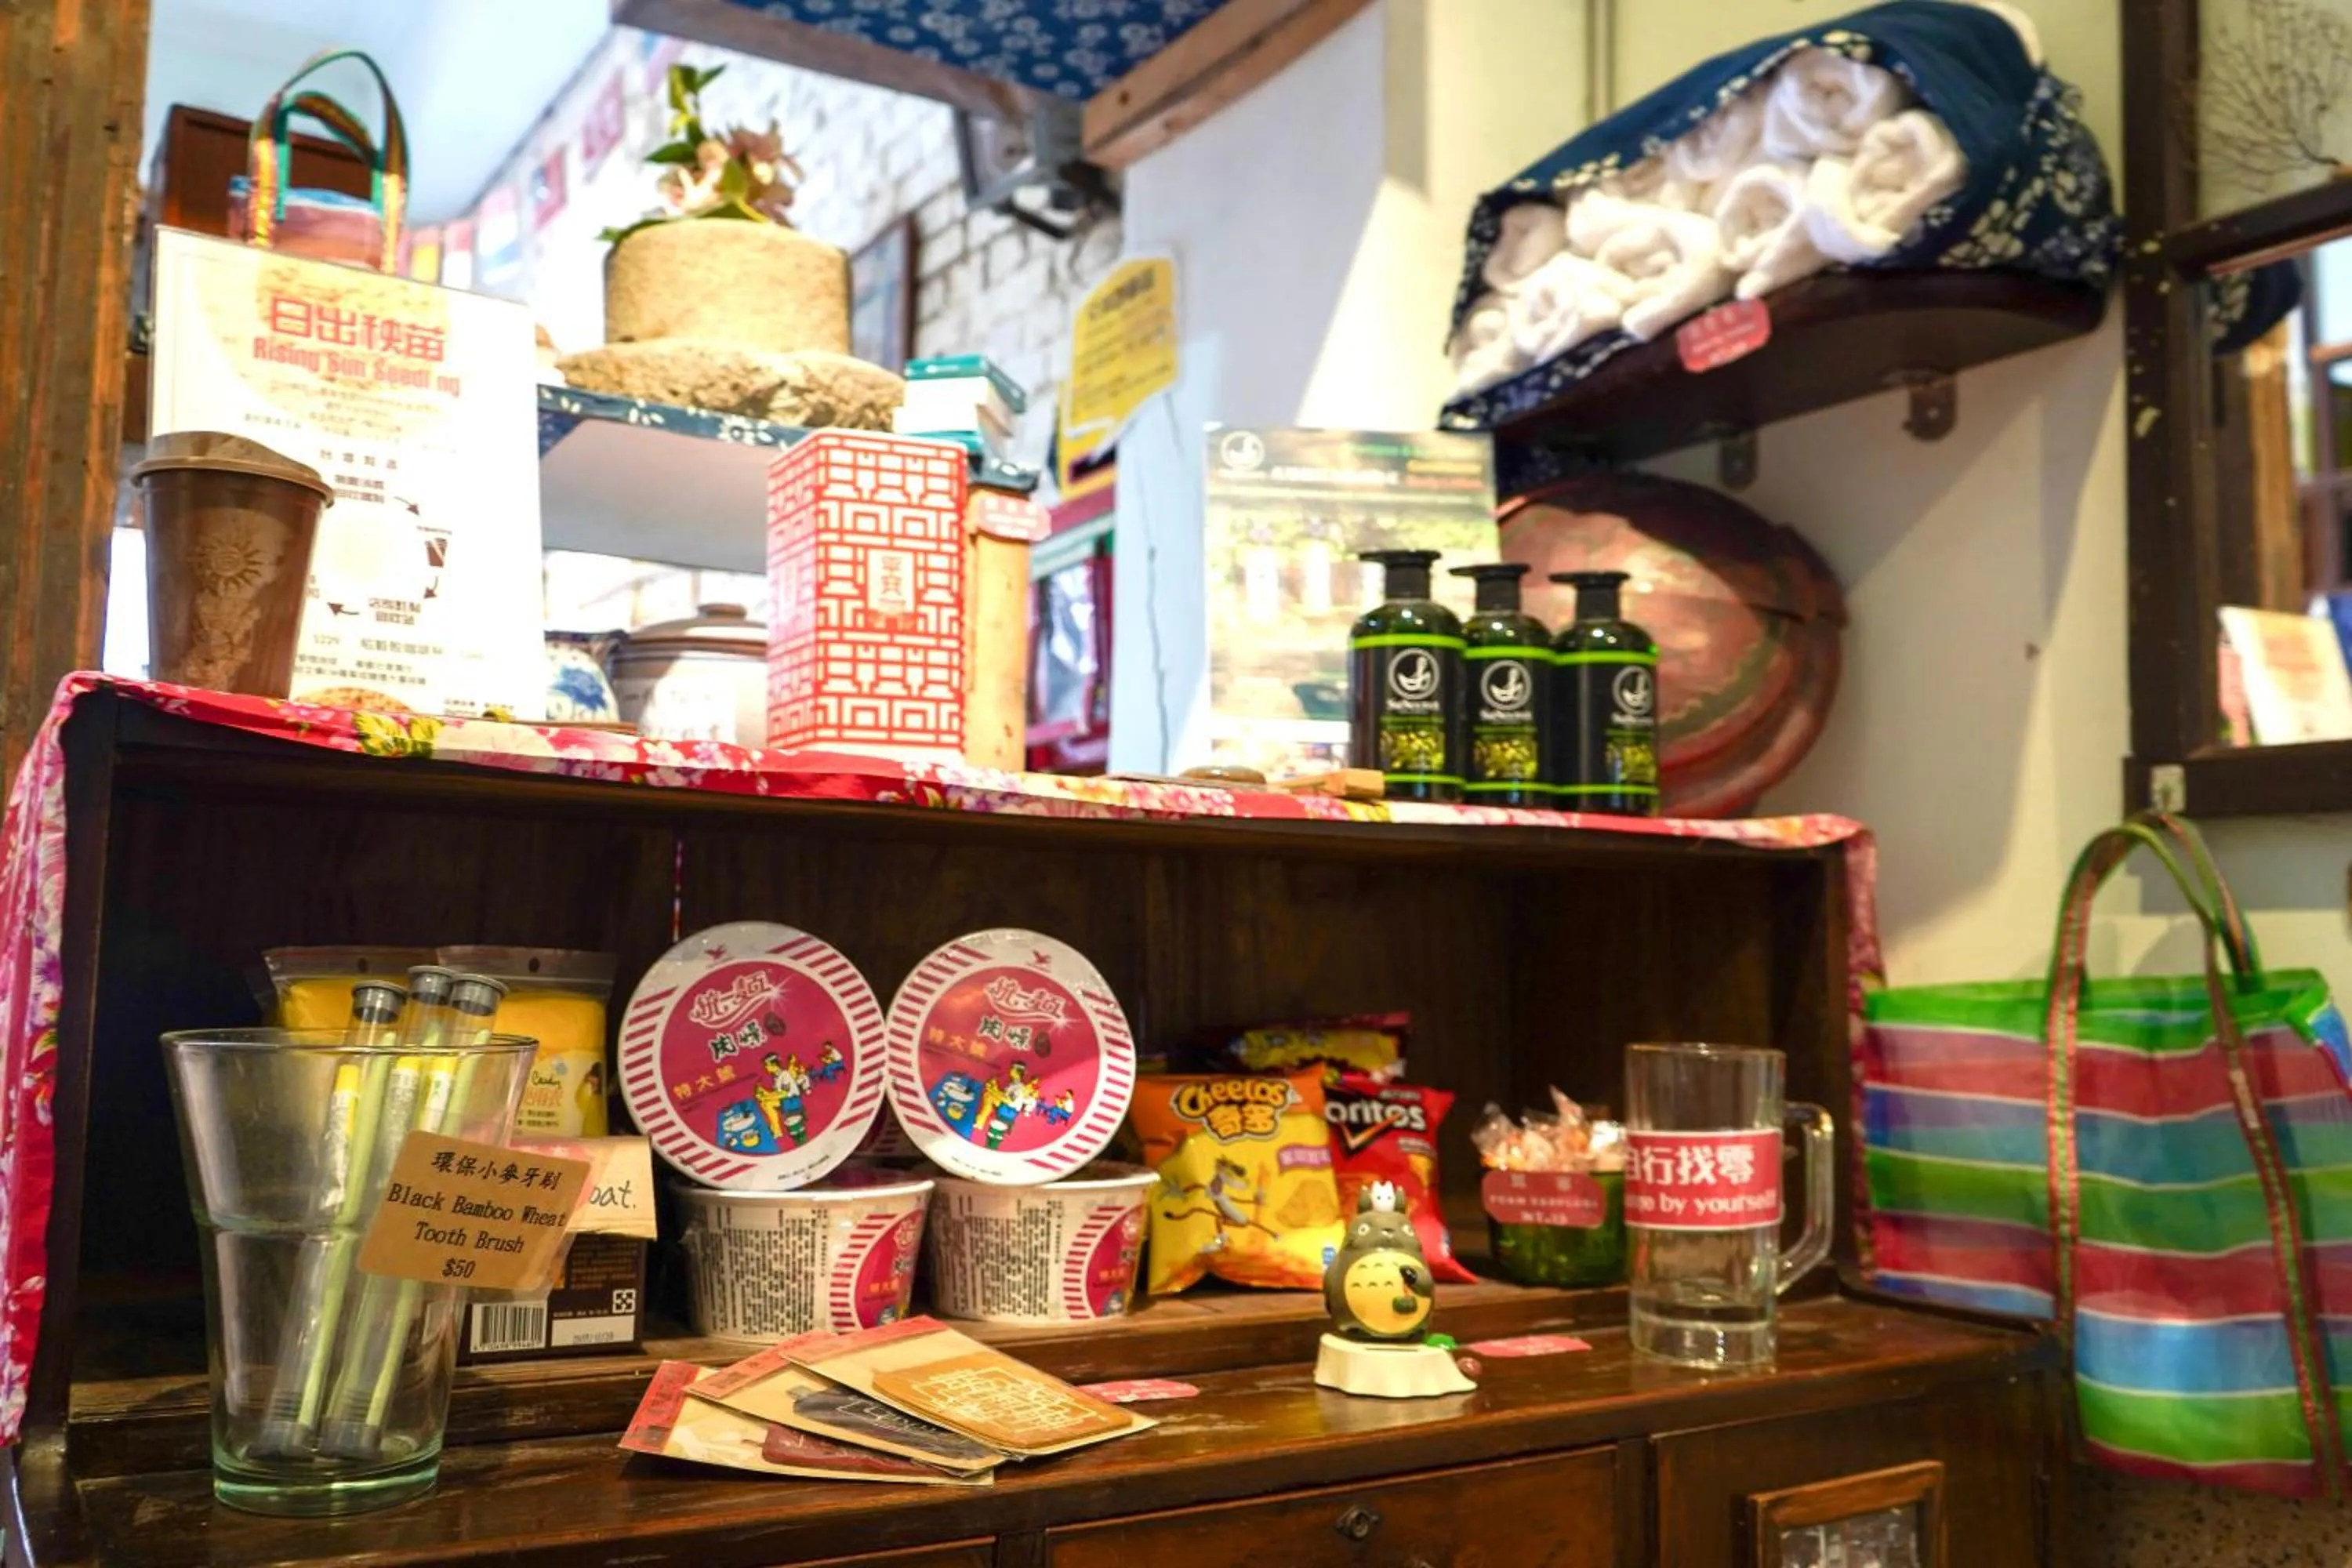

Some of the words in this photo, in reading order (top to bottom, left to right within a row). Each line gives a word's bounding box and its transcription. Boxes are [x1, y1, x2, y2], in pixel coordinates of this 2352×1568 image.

[270, 297, 445, 362] 日出秧苗
[253, 337, 320, 372] Rising
[1176, 1079, 1289, 1118] Cheetos
[1325, 1099, 1427, 1131] oritos
[387, 1183, 445, 1211] Black
[451, 1196, 514, 1221] Bamboo
[521, 1205, 565, 1227] Wheat
[1660, 1192, 1687, 1216] by
[1693, 1188, 1777, 1217] yourself
[414, 1221, 467, 1247] Tooth
[474, 1232, 524, 1254] Brush
[442, 1259, 476, 1279] $50
